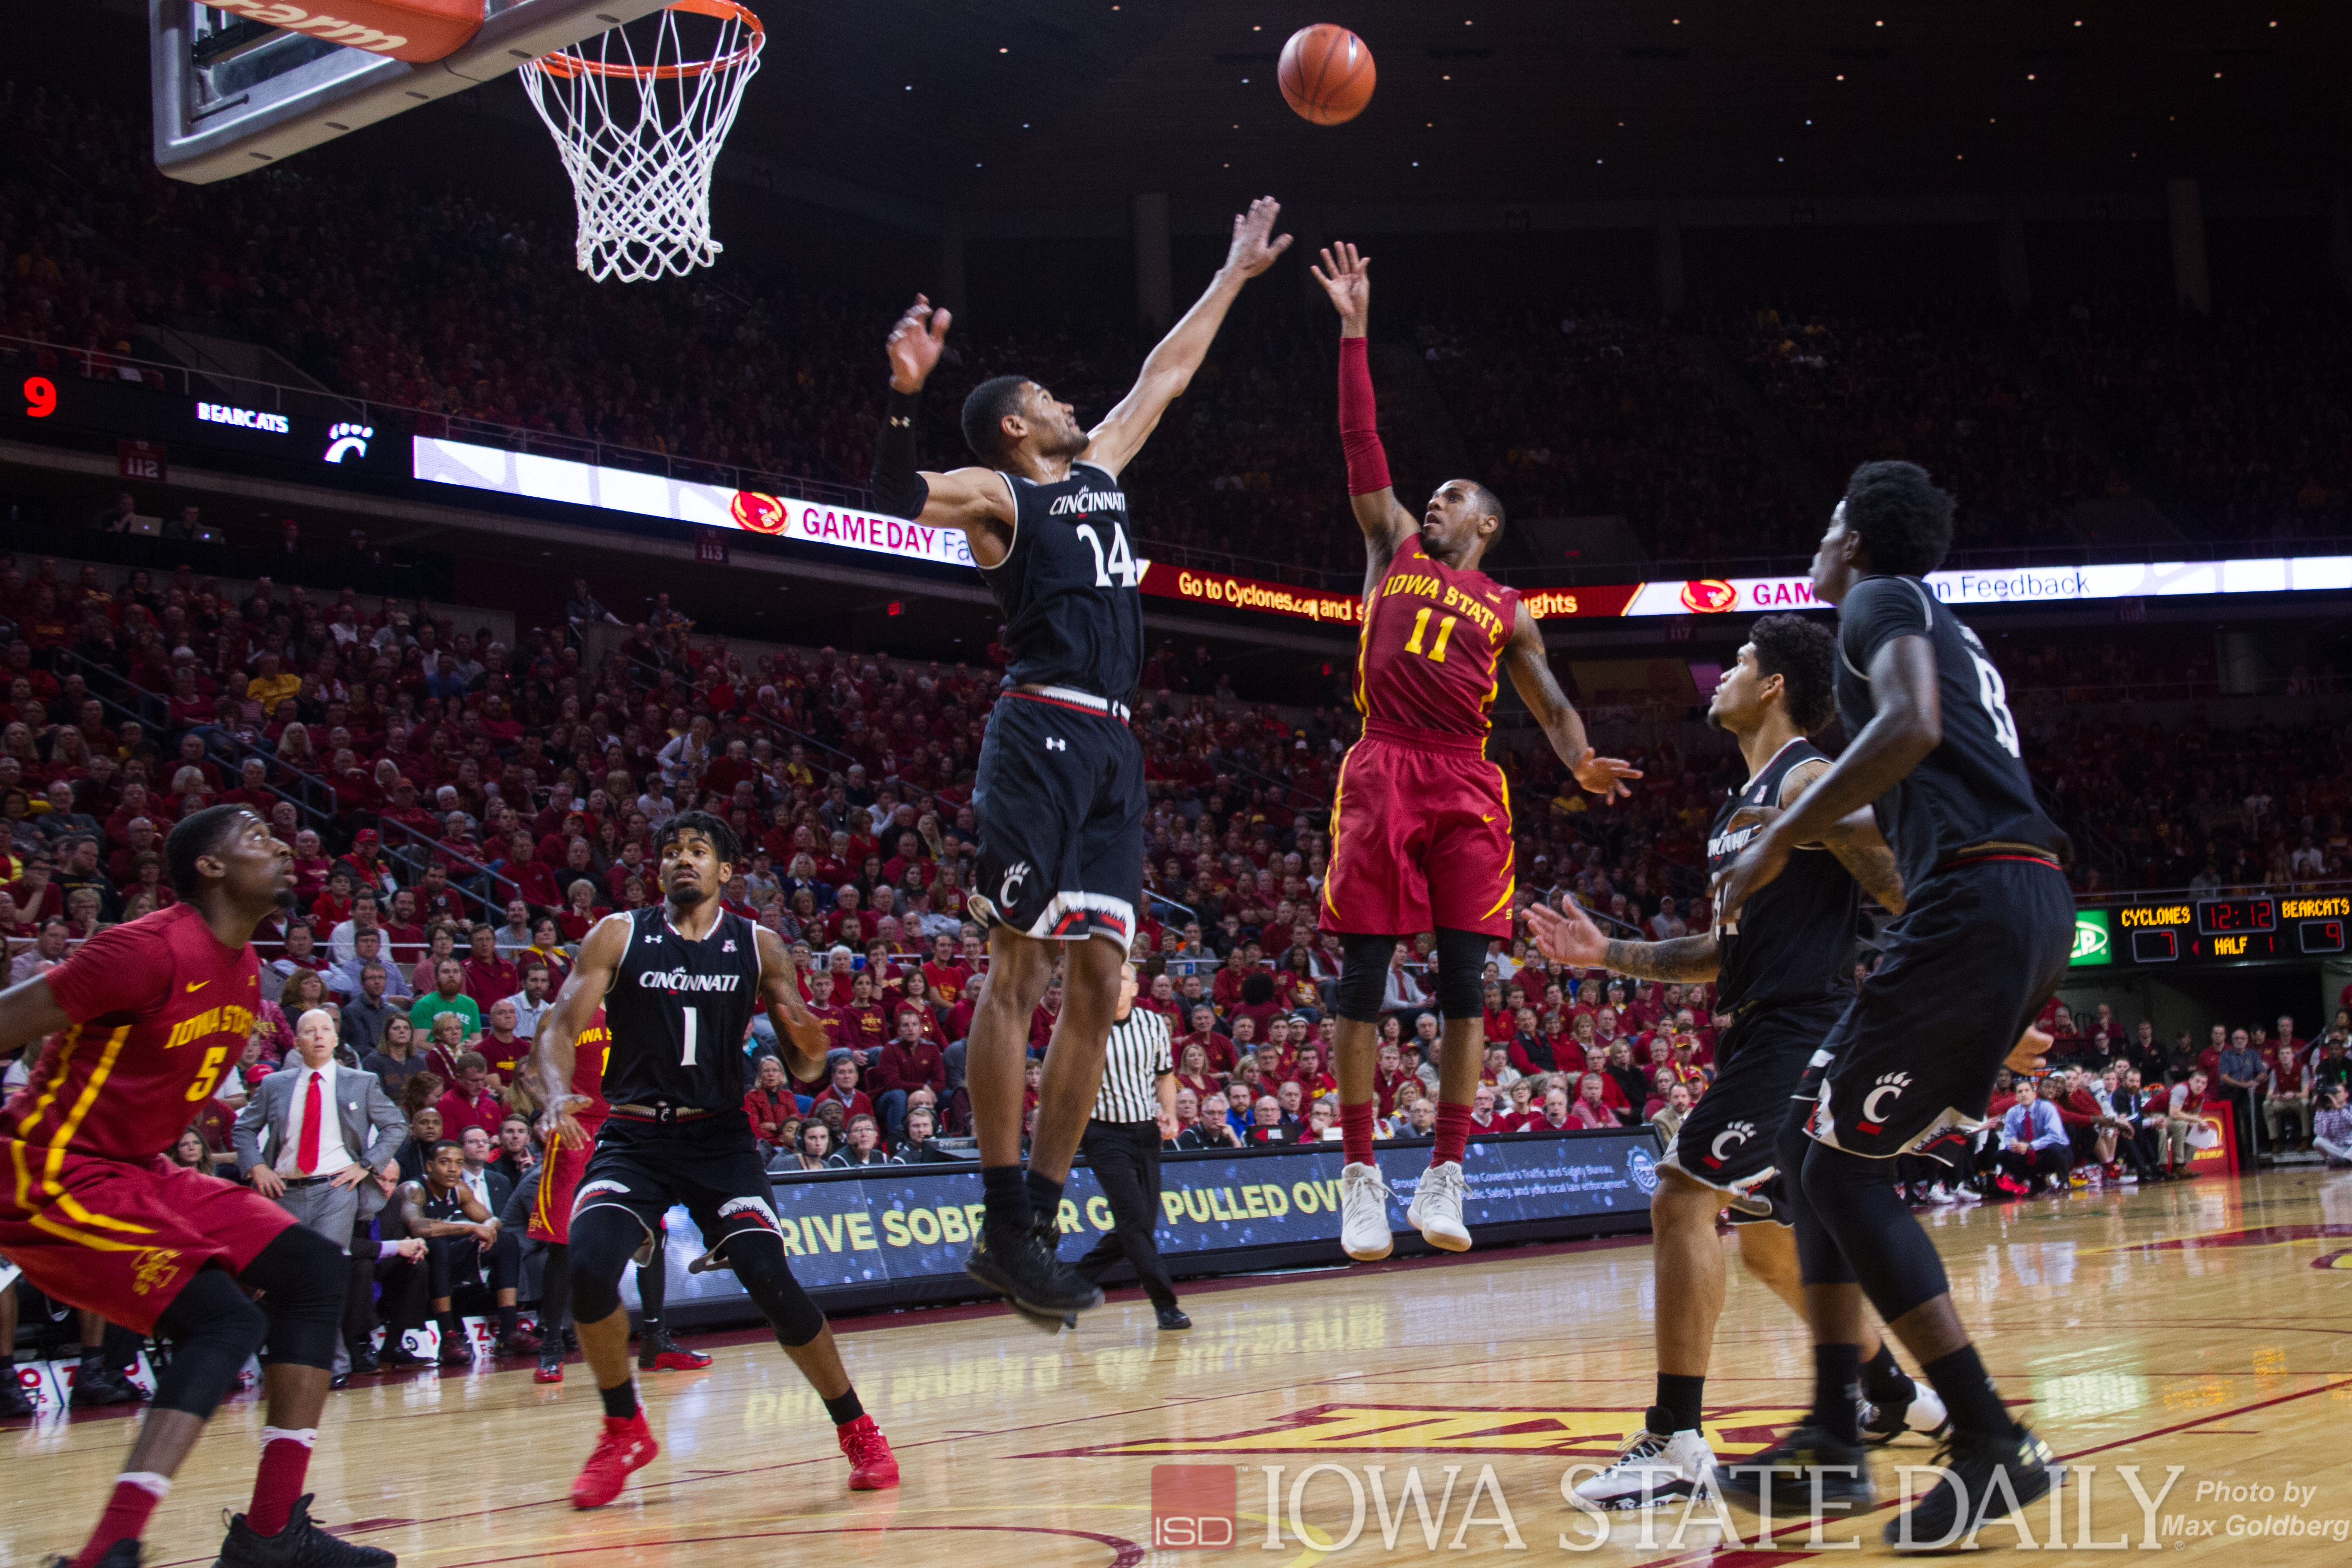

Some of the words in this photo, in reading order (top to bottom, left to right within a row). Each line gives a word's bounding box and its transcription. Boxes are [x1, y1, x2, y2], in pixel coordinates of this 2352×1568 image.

[24, 377, 56, 417] 9
[197, 402, 289, 433] BEARCATS
[127, 457, 159, 478] 112
[1049, 491, 1125, 515] CINCINNATI
[803, 508, 935, 554] GAMEDAY
[943, 531, 970, 561] Fa
[1076, 521, 1137, 587] 14
[1179, 572, 1203, 596] Go
[1205, 578, 1223, 600] to
[1320, 599, 1352, 620] and
[1961, 572, 2090, 598] Feedback
[1382, 574, 1441, 600] IOWA
[1443, 585, 1504, 645] STATE
[1404, 607, 1457, 663] 11
[2121, 906, 2191, 927] CYCLONES
[2211, 902, 2271, 929] 12:12
[2282, 897, 2350, 918] BEARCATS
[2161, 931, 2174, 955] 7
[2214, 936, 2248, 956] HALF
[2326, 923, 2341, 947] 9
[639, 971, 740, 992] CINCINNATI
[680, 1006, 698, 1066] 1
[184, 1046, 228, 1102] 5
[1513, 1186, 1529, 1196] and
[1548, 1182, 1567, 1194] local
[1547, 1166, 1562, 1178] and
[782, 1212, 878, 1256] RIVE
[882, 1205, 986, 1247] SOBE
[1160, 1184, 1289, 1225] PULLED
